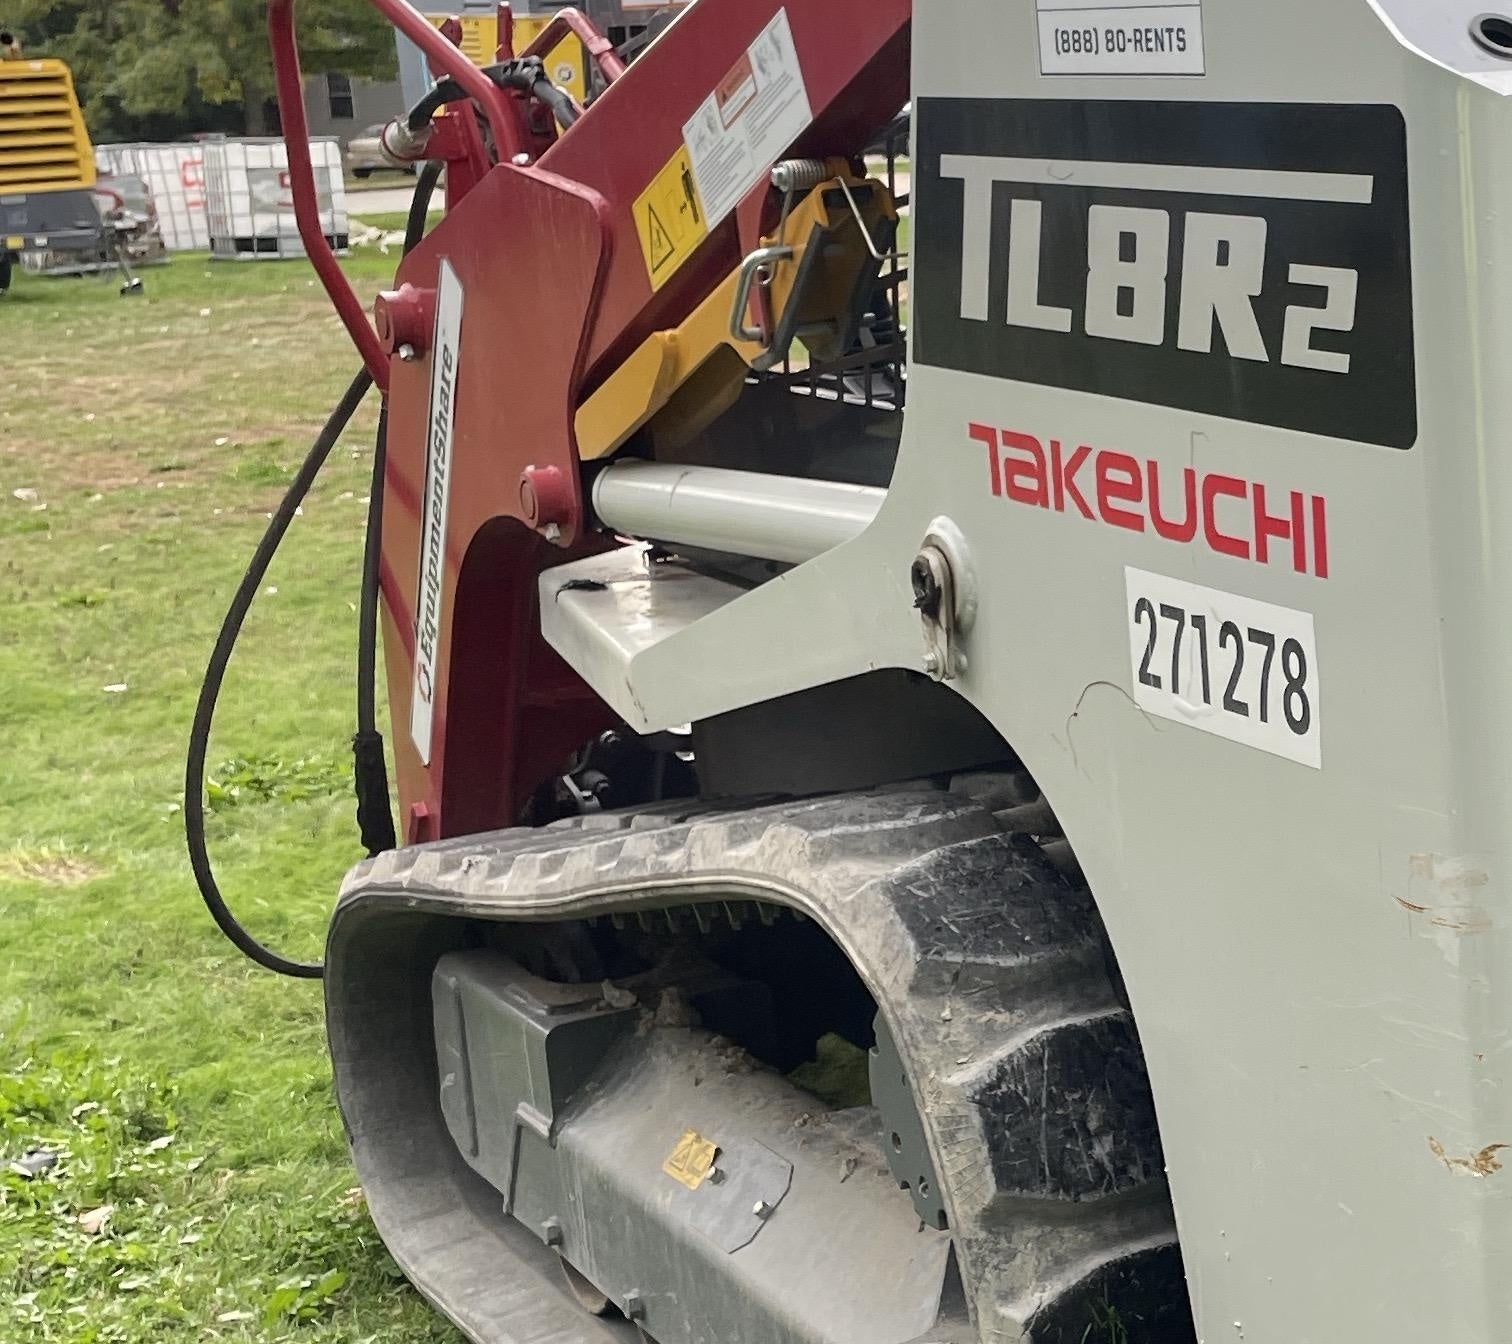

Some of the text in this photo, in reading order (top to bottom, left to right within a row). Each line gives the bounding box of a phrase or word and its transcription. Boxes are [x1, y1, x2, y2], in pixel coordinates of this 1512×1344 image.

[1054, 26, 1187, 55] (888) 80-RENTS
[939, 153, 1374, 374] TL8R2
[420, 343, 453, 666] EquipmentShare
[968, 421, 1329, 580] TAKEUCHI
[1133, 596, 1312, 736] 271278
